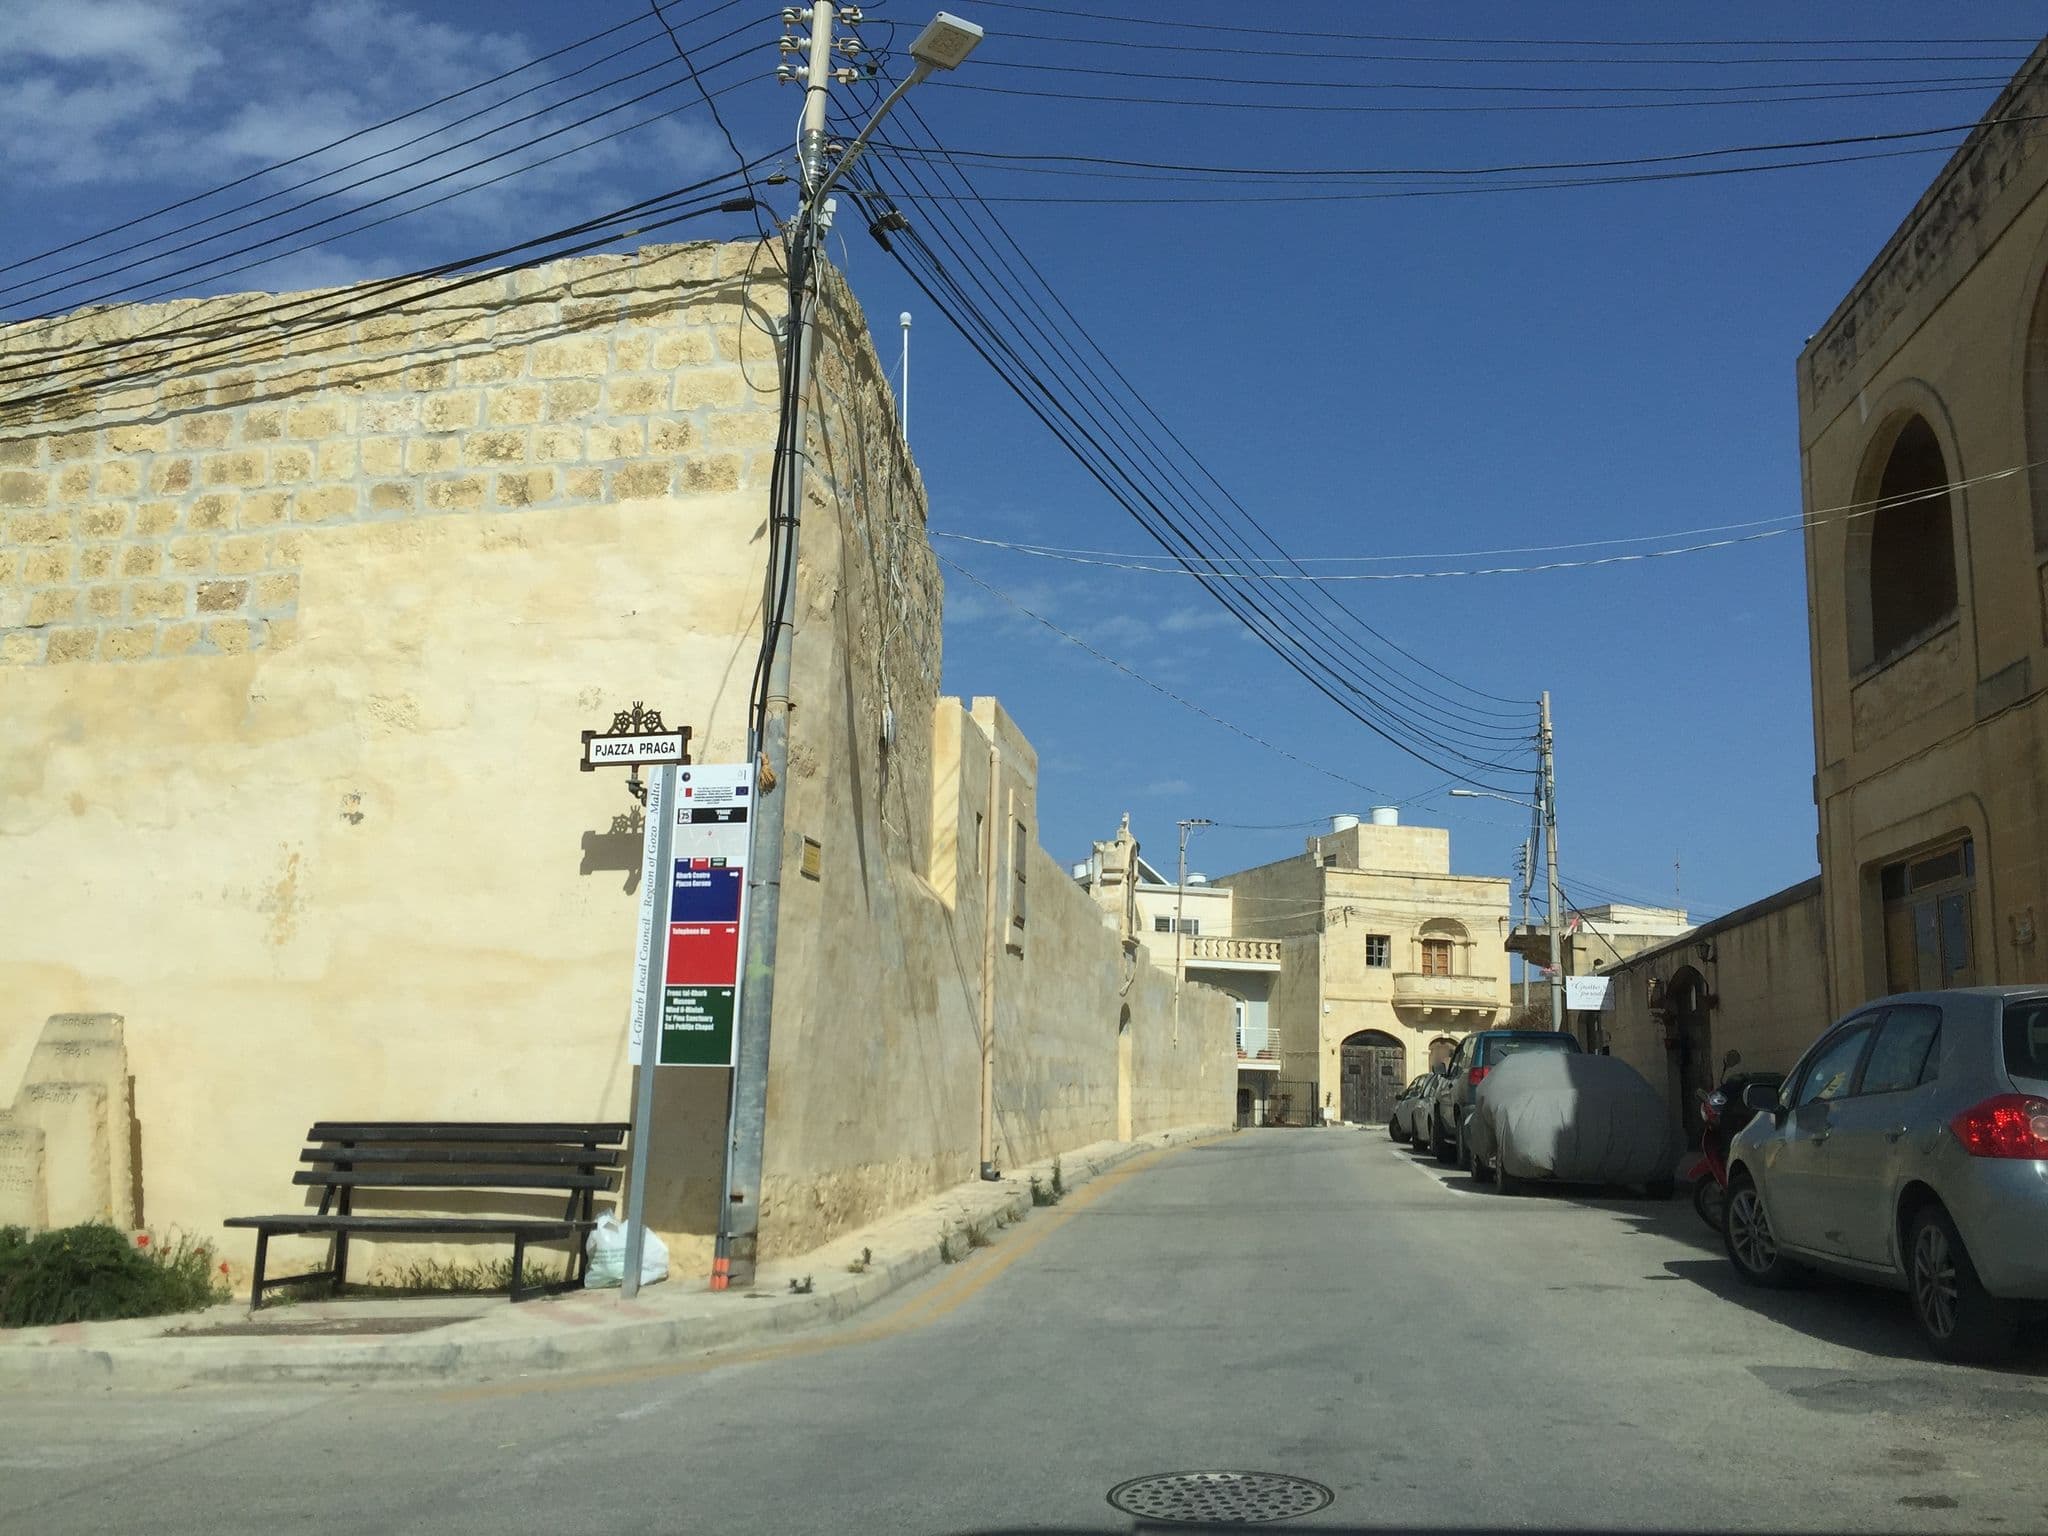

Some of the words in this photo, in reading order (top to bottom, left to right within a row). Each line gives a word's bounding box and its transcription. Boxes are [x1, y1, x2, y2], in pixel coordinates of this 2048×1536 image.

[595, 743, 634, 757] PJAZZA
[640, 741, 676, 754] PRAGA
[650, 782, 661, 815] Malta
[648, 826, 658, 854] Gozo
[648, 857, 657, 869] of
[643, 877, 655, 907] Region
[639, 918, 650, 962] Council
[672, 927, 700, 935] Telephone
[638, 964, 647, 994] Local
